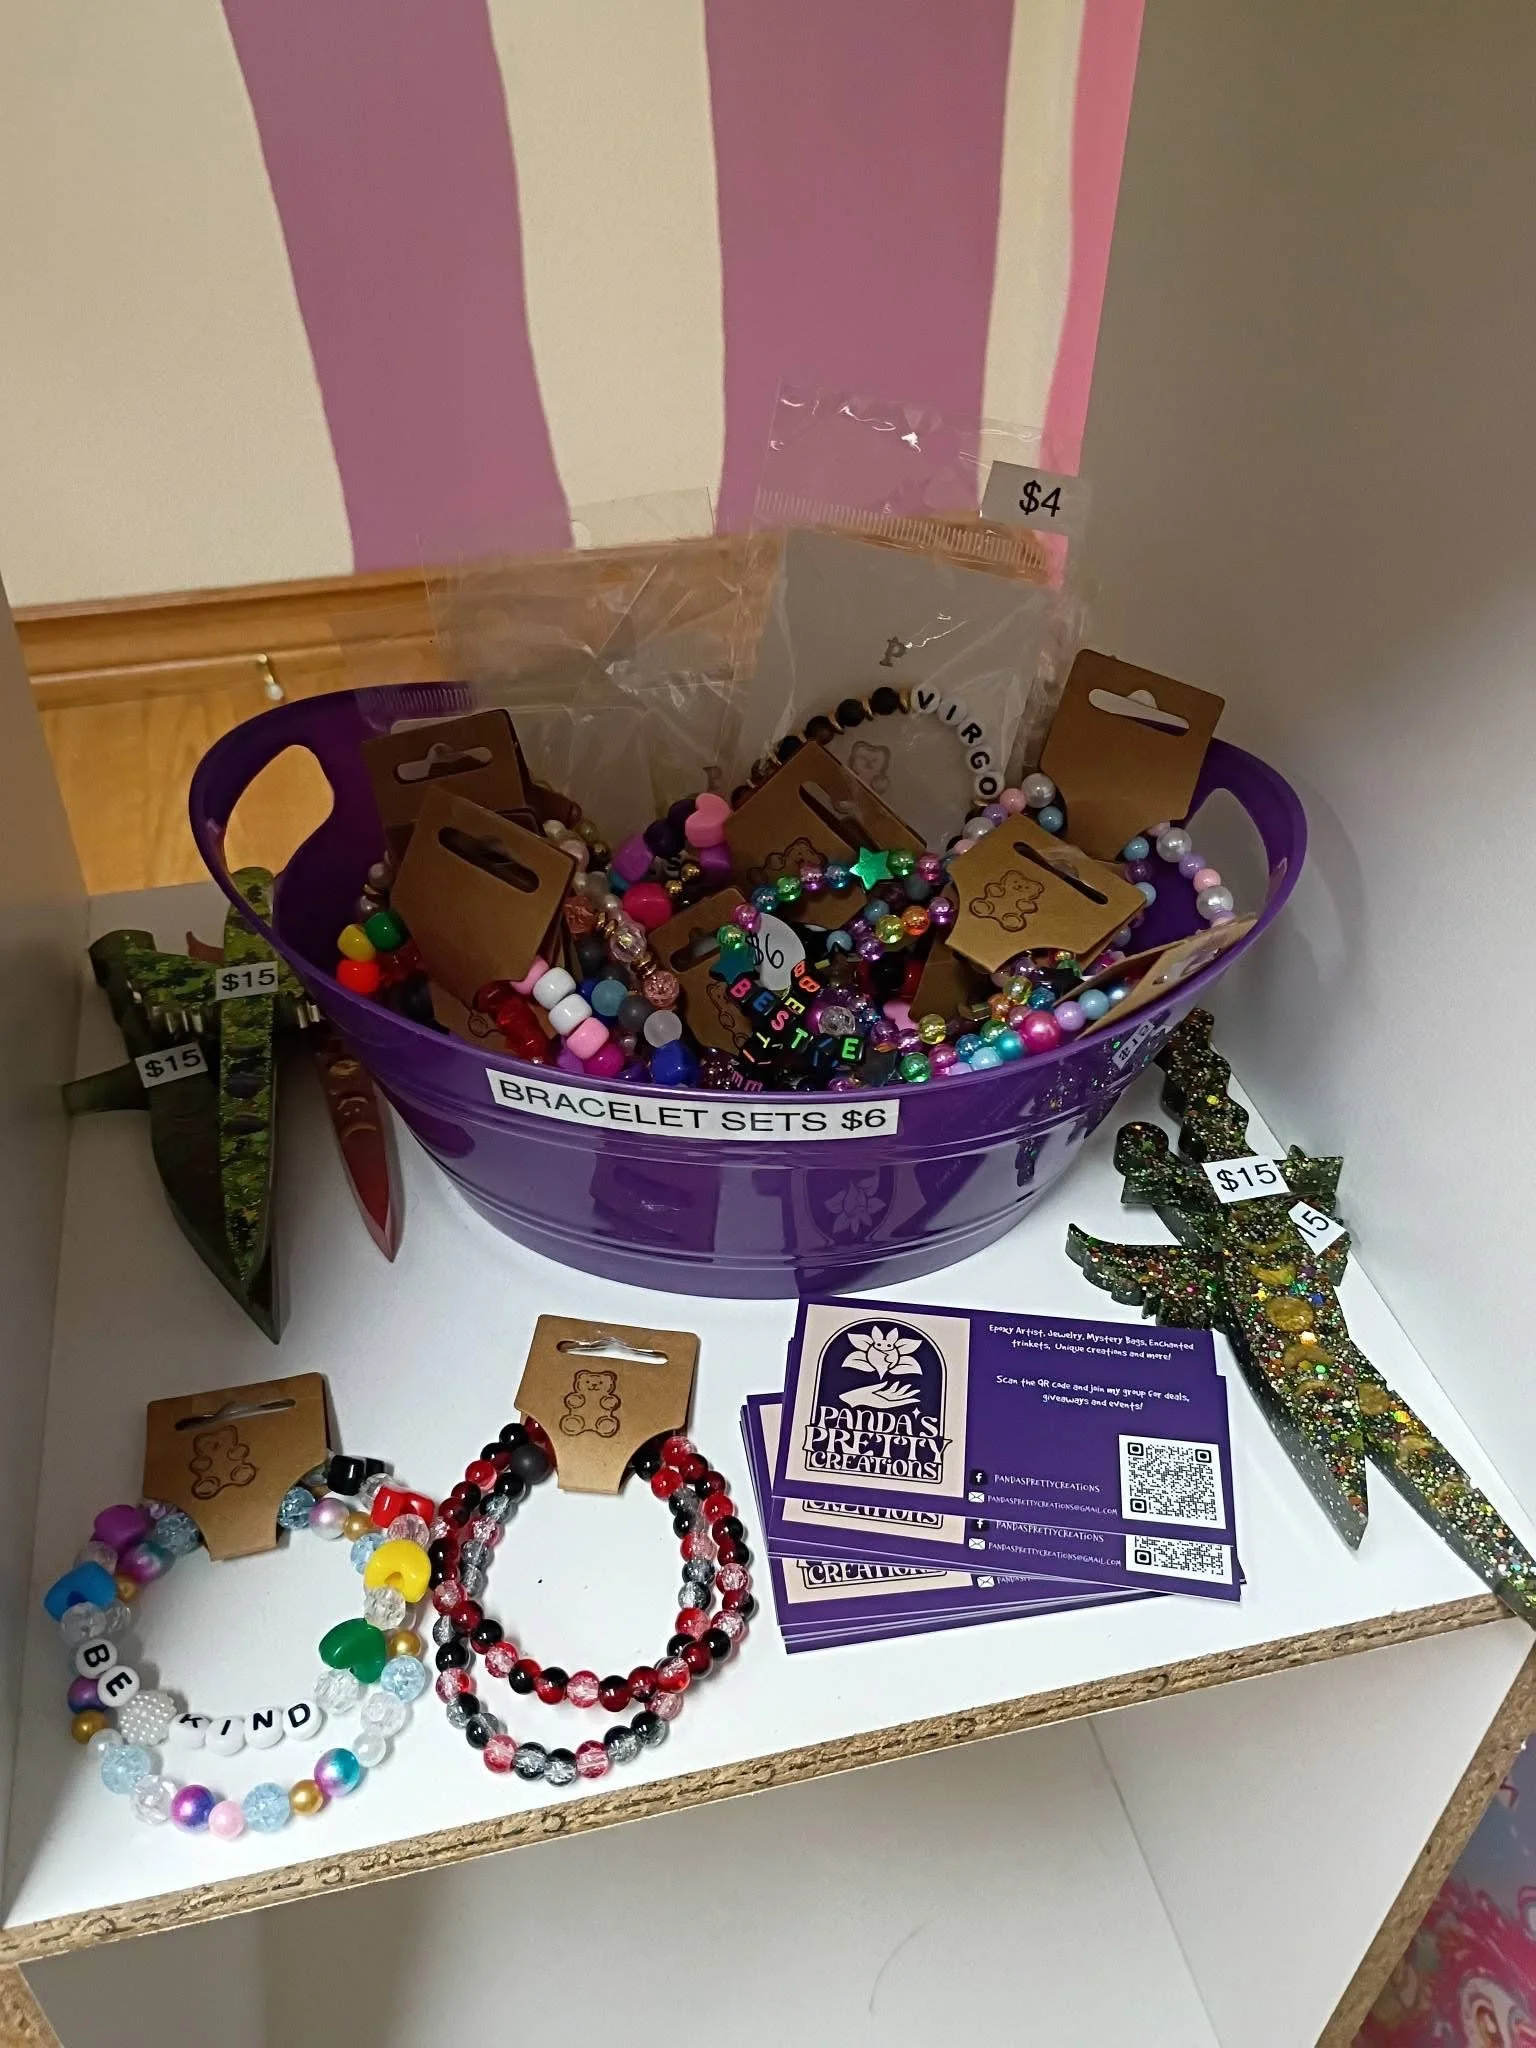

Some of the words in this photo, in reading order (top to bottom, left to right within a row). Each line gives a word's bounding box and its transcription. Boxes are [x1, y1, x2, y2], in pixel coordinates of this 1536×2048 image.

[1018, 479, 1062, 518] $4
[917, 690, 998, 796] VIRGO
[221, 968, 276, 992] $15
[144, 1049, 201, 1079] $15
[499, 1079, 708, 1129] BRACELET
[721, 1110, 828, 1132] SETS
[841, 1107, 887, 1132] $6
[1216, 1163, 1278, 1193] $15
[989, 1324, 1014, 1335] Epoxy
[1086, 1332, 1123, 1345] Mystery
[1055, 1343, 1085, 1354] Unique
[1129, 1350, 1145, 1360] and
[1146, 1350, 1172, 1361] more!
[996, 1375, 1018, 1386] Scan
[1020, 1377, 1036, 1388] the
[1037, 1379, 1050, 1389] QR
[1051, 1380, 1071, 1390] code
[1072, 1383, 1089, 1392] and
[1089, 1384, 1105, 1395] join
[1106, 1386, 1121, 1396] my
[1122, 1388, 1147, 1399] group
[1042, 1393, 1090, 1406] giveaways
[1091, 1398, 1107, 1408] and
[1108, 1400, 1144, 1412] events!
[804, 1425, 953, 1463] PRETTY
[83, 1643, 133, 1698] BE
[178, 1702, 312, 1737] KIND
